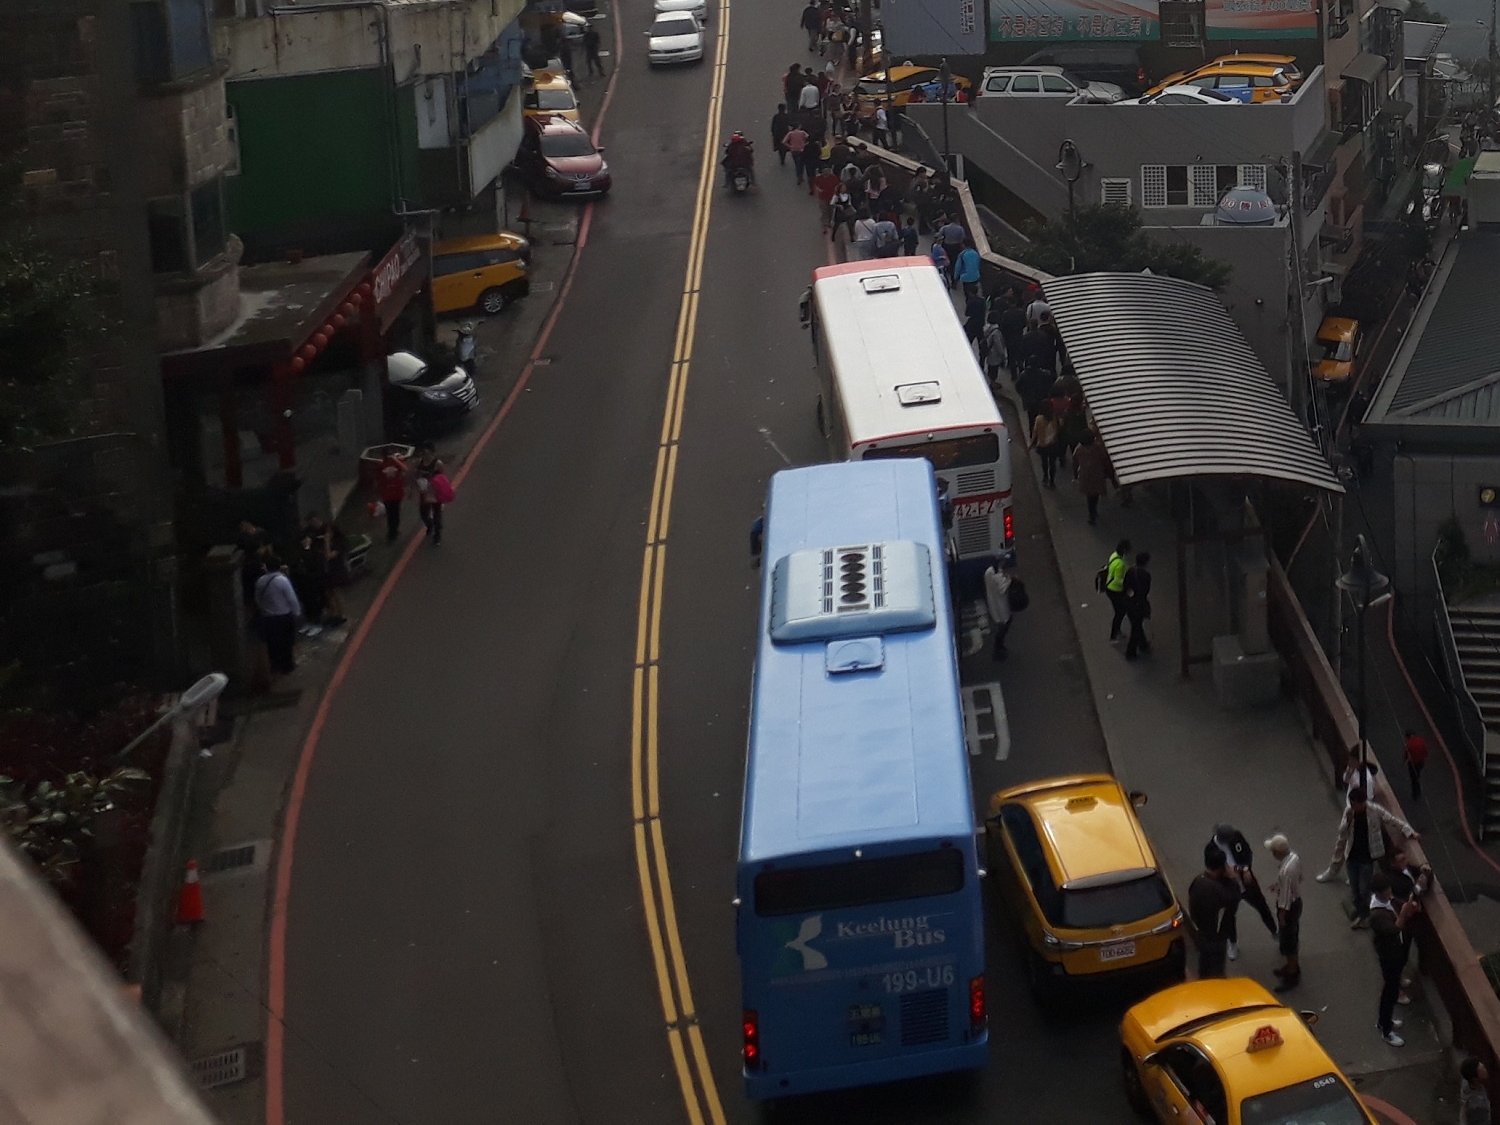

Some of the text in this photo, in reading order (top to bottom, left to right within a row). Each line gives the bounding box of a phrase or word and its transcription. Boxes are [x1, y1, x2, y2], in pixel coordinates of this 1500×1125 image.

[953, 500, 995, 517] 42-FZ
[837, 916, 930, 937] Keelung
[894, 929, 946, 949] Bus
[883, 965, 954, 993] 199-U6
